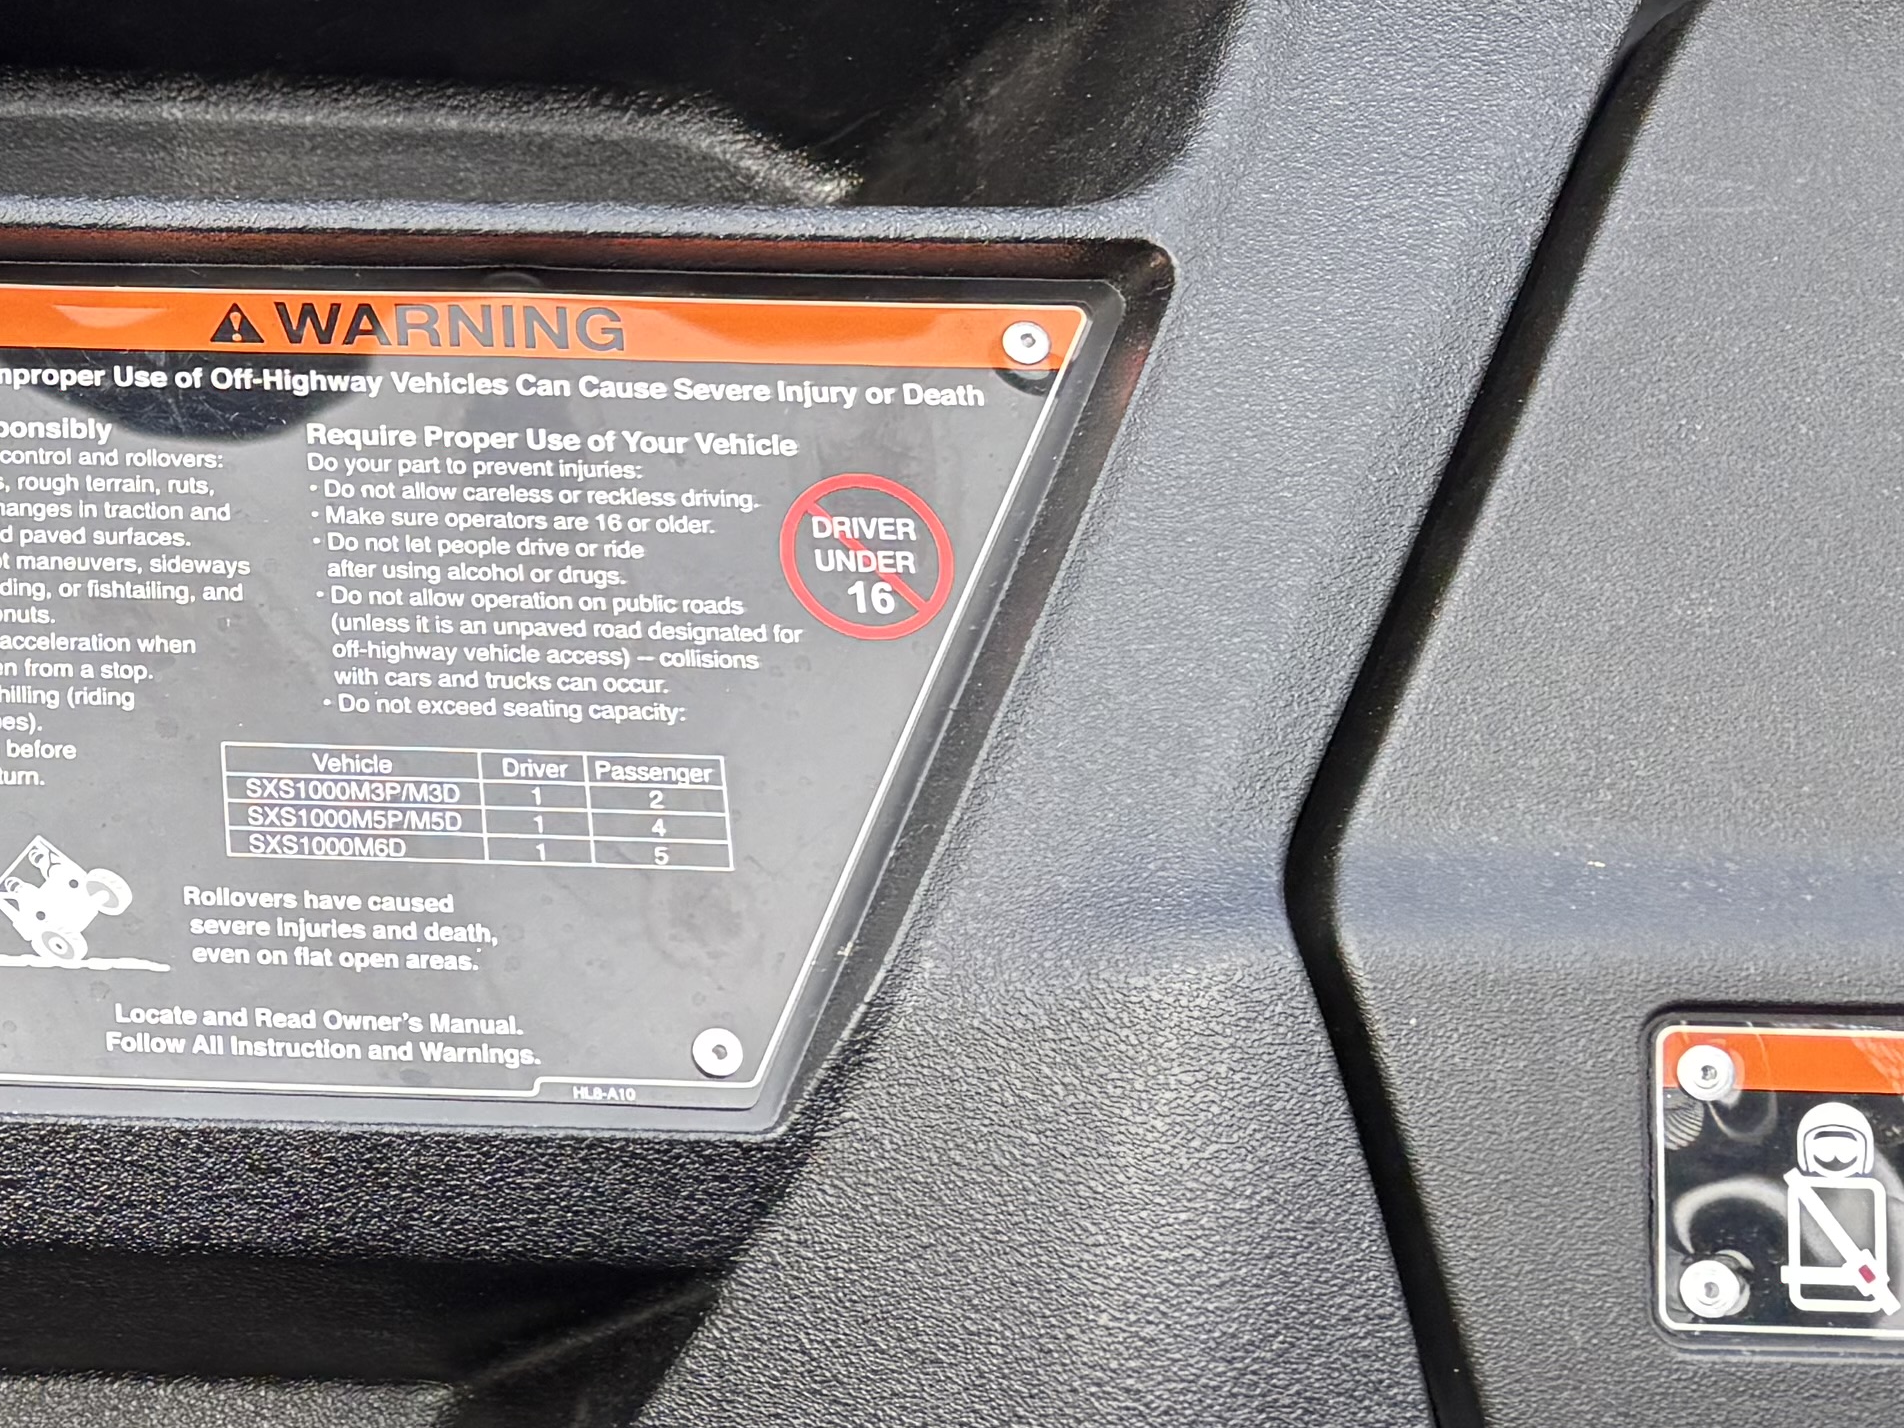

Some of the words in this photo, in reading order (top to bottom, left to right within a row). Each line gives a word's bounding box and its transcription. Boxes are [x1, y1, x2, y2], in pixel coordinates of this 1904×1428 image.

[273, 301, 625, 352] WARNING
[113, 365, 168, 388] Use
[174, 367, 203, 389] of
[210, 367, 384, 399] Off-Highway
[389, 371, 509, 396] Vehicles
[515, 373, 571, 397] Can
[578, 375, 669, 400] Cause
[673, 377, 773, 402] Severe
[777, 379, 858, 410] Injury
[865, 386, 897, 405] or
[902, 382, 985, 407] Death
[306, 422, 417, 452] Require
[423, 425, 520, 454] Proper
[525, 427, 581, 452] Use
[587, 429, 617, 453] of
[621, 430, 691, 454] Your
[693, 431, 799, 457] Vehicle
[78, 447, 119, 467] and
[125, 447, 224, 469] rollovers:
[307, 452, 339, 472] Do
[343, 457, 393, 477] your
[397, 456, 442, 477] part
[445, 457, 467, 475] to
[472, 459, 555, 479] prevent
[558, 458, 644, 483] injuries:
[17, 473, 80, 496] rough
[85, 474, 161, 496] terrain,
[167, 476, 215, 497] ruts,
[325, 505, 385, 526] Make
[391, 511, 439, 527] sure
[444, 511, 549, 532] operators
[553, 515, 589, 531] are
[594, 513, 623, 533] 16
[627, 517, 652, 533] or
[655, 514, 716, 535] older.
[811, 515, 917, 541] DRIVER
[327, 531, 359, 552] Do
[364, 535, 400, 553] not
[405, 533, 433, 553] let
[437, 535, 511, 559] people
[515, 537, 570, 557] drive
[574, 542, 599, 558] or
[603, 539, 645, 560] ride
[15, 555, 143, 575] maneuvers,
[149, 553, 251, 579] sideways
[813, 548, 917, 574] UNDER
[847, 579, 896, 615] 16
[6, 738, 77, 760] before
[311, 752, 393, 774] Vehicle
[501, 757, 569, 779] Driver
[594, 760, 714, 786] Passenger
[245, 777, 461, 803] SXS1000M3P/M3D
[530, 786, 542, 806] 1
[648, 789, 666, 810] 2
[247, 805, 463, 832] SXS1000M5P/M5D
[532, 814, 544, 834] 1
[650, 818, 667, 837] 4
[248, 832, 407, 858] SXS1000M6D
[535, 842, 546, 862] 1
[653, 846, 670, 866] 5
[183, 885, 299, 909] Rollovers
[303, 889, 363, 911] have
[367, 893, 455, 913] caused
[189, 918, 271, 937] severe
[276, 916, 367, 943] injuries
[372, 920, 418, 941] and
[423, 921, 499, 947] death,
[191, 947, 251, 964] even
[256, 948, 289, 966] on
[293, 945, 334, 967] flat
[338, 951, 399, 973] open
[405, 953, 482, 971] areas.
[115, 1002, 198, 1026] Locate
[202, 1007, 249, 1027] and
[254, 1007, 317, 1029] Read
[322, 1009, 424, 1033] Owner's
[429, 1012, 525, 1036] Manual.
[105, 1031, 187, 1054] Follow
[191, 1033, 224, 1055] All
[230, 1035, 362, 1060] Instruction
[367, 1040, 414, 1062] and
[419, 1041, 542, 1069] Warnings.
